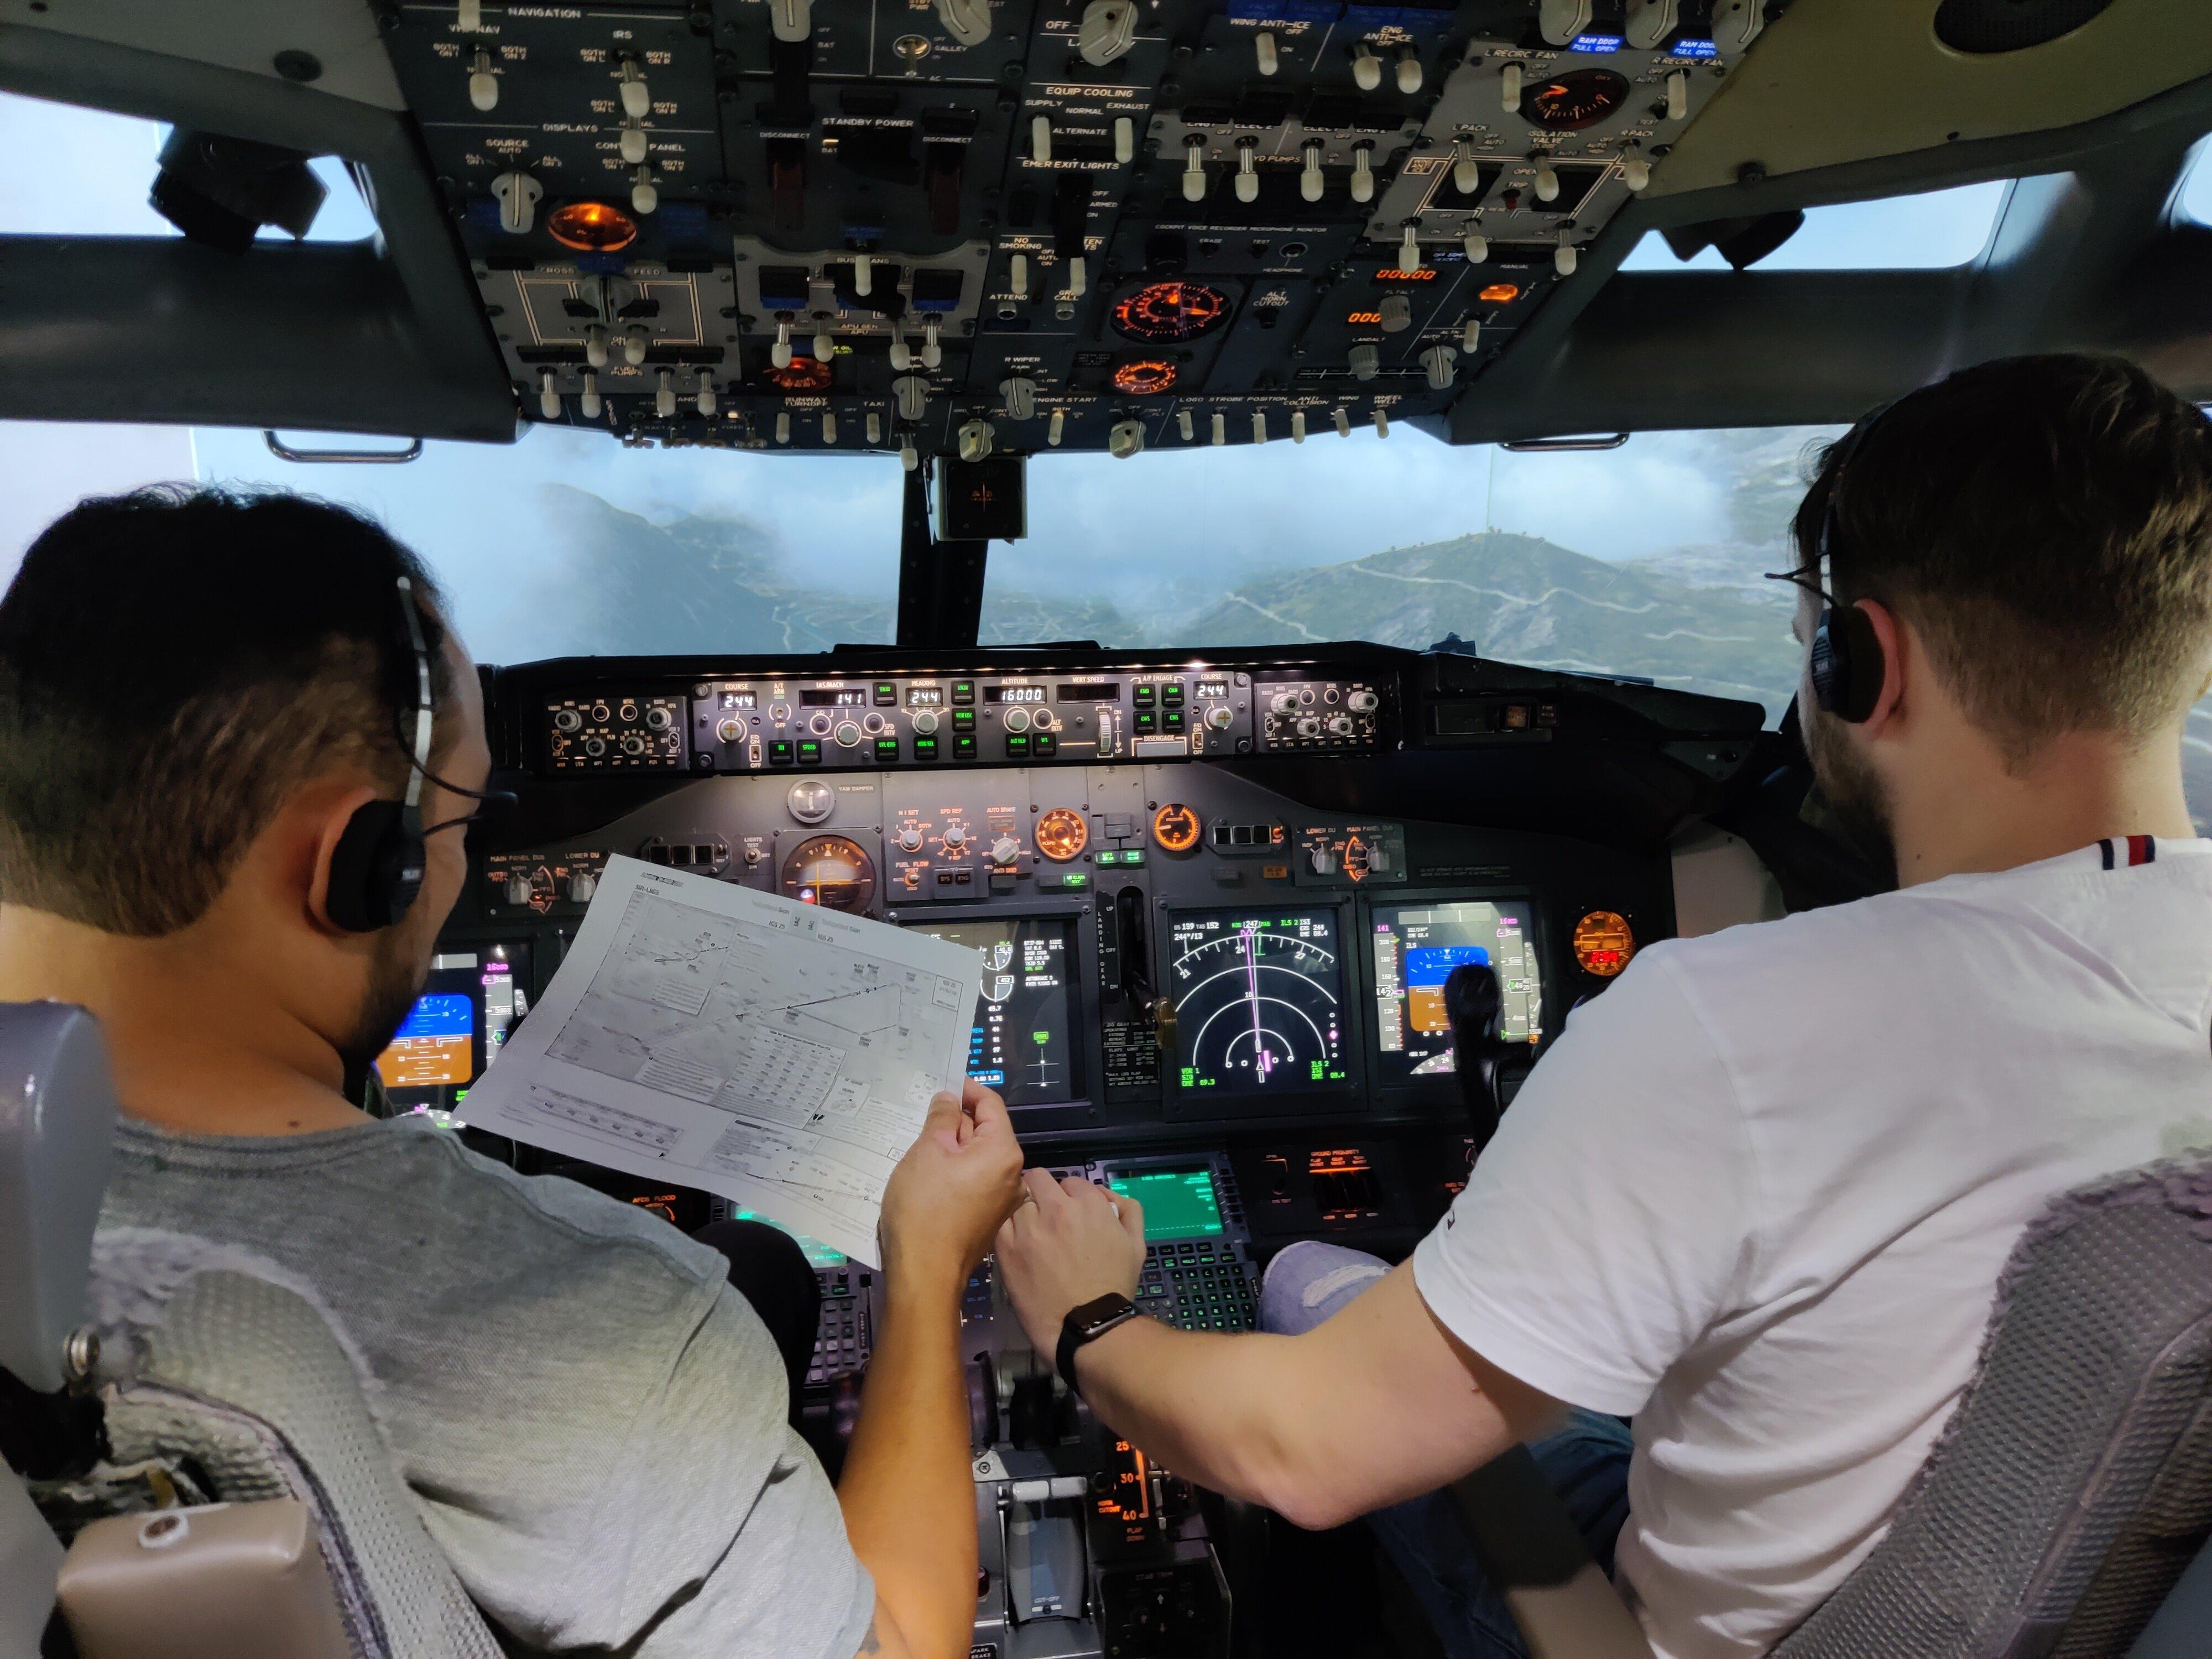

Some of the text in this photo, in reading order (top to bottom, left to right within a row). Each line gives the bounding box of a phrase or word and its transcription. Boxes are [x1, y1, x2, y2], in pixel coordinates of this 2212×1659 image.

[509, 7, 581, 18] NAVIGATION
[1046, 21, 1070, 29] OFF
[1259, 20, 1312, 29] ANTI-ICE
[479, 25, 500, 34] NAV
[613, 30, 633, 39] IRS
[1363, 34, 1413, 42] ANTI-ICE
[434, 43, 459, 51] BOTH
[501, 46, 526, 54] BOTH
[580, 49, 606, 57] BOTH
[646, 51, 671, 59] BOTH
[1494, 50, 1533, 59] RECIRC
[1661, 58, 1699, 66] RECIRC
[1046, 87, 1133, 97] EQUIP COOLING
[1107, 102, 1150, 111] EXHAUST
[822, 118, 914, 127] STANDBY POWER
[543, 124, 598, 133] DISPLAYS
[1052, 127, 1107, 135] ALTERNATE
[1528, 131, 1578, 139] ISOLATION
[486, 139, 529, 148] SOURCE
[649, 143, 686, 152] PANEL
[1022, 160, 1119, 170] EMER EXIT LIGHTS
[912, 690, 938, 702] 244
[1001, 690, 1042, 701] 16000
[1198, 686, 1224, 697] 244
[725, 696, 753, 707] 244
[837, 693, 862, 704] 141
[1116, 1441, 1130, 1451] 25
[1120, 1473, 1134, 1483] 30
[1123, 1511, 1136, 1520] 40
